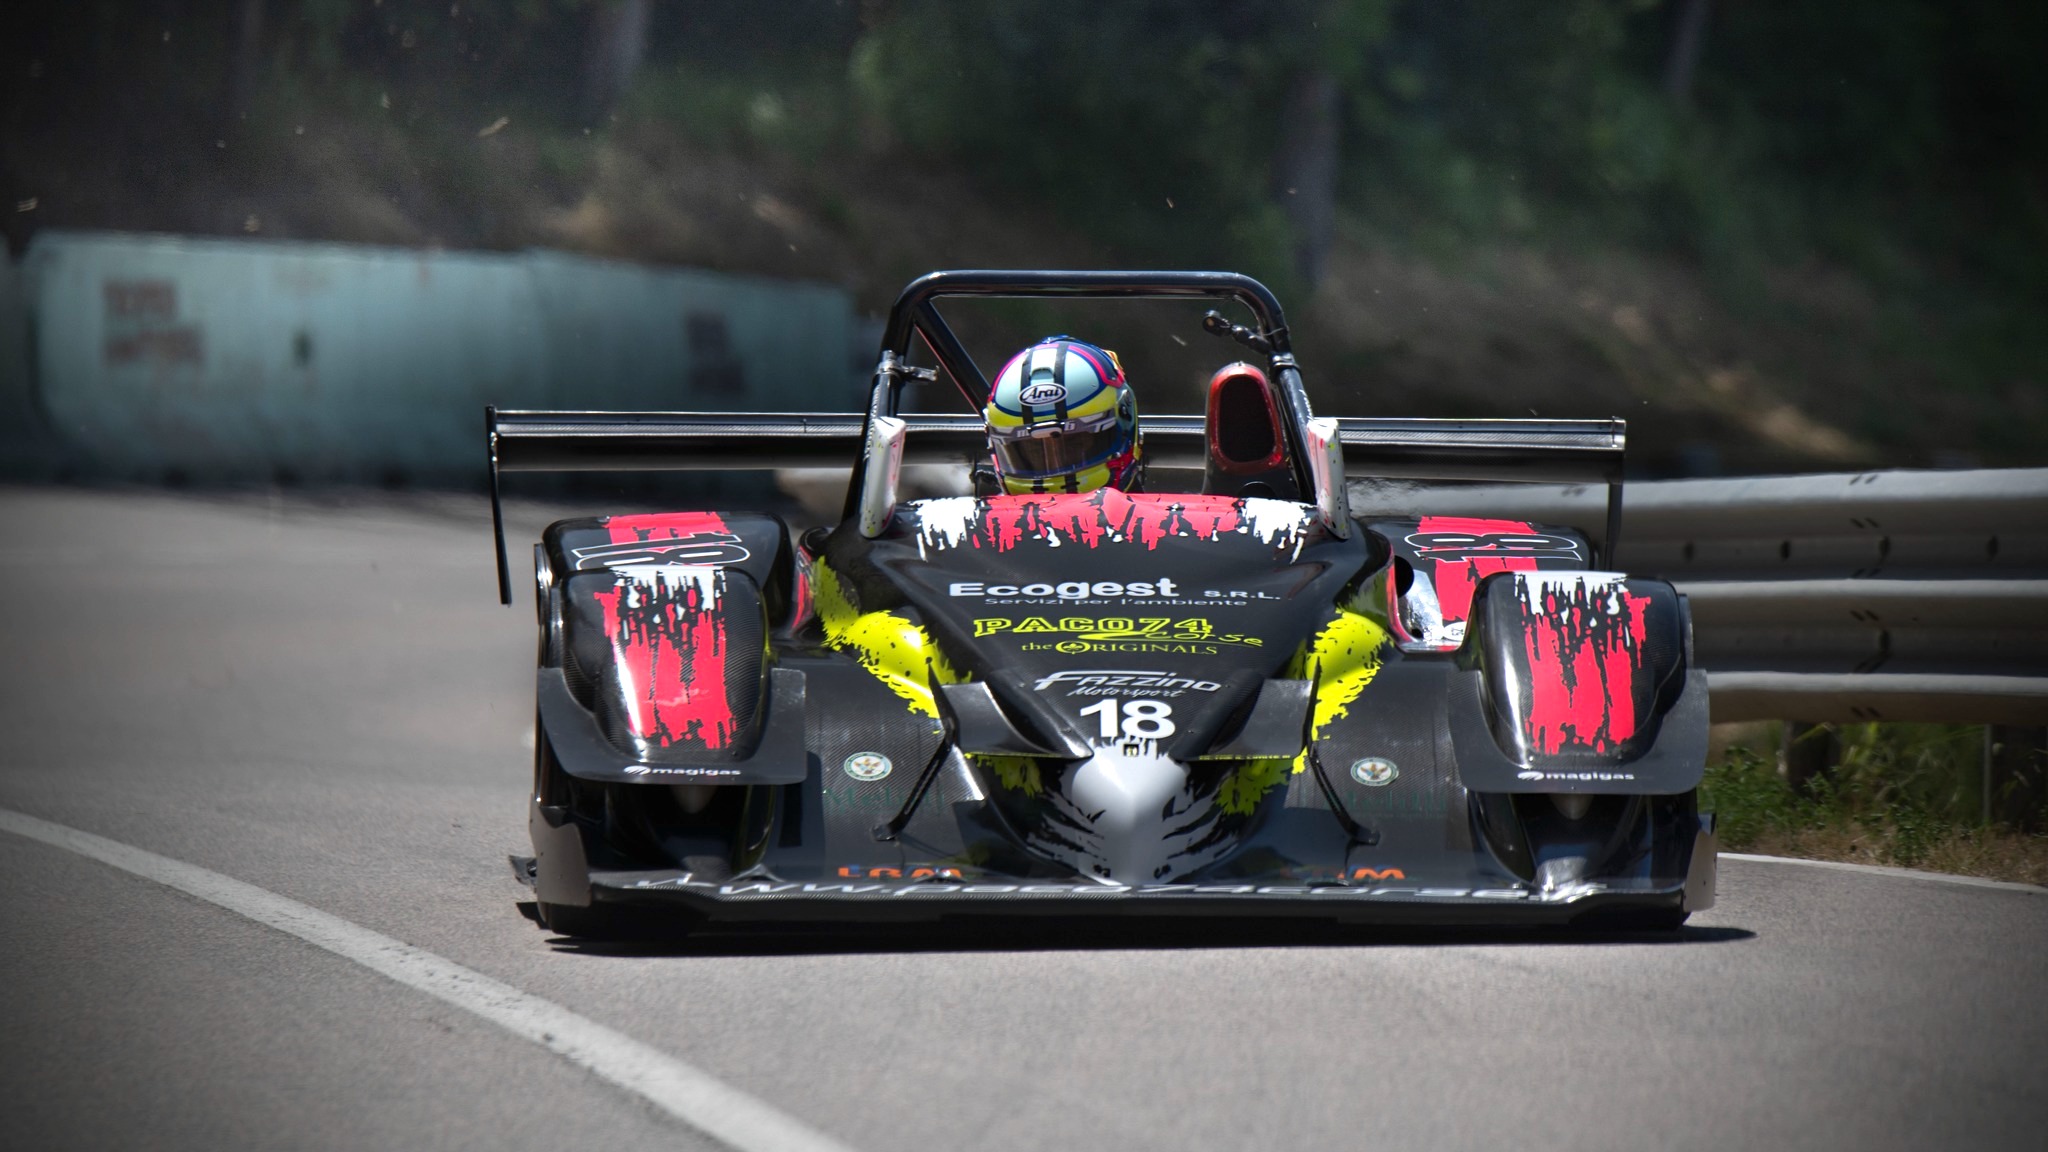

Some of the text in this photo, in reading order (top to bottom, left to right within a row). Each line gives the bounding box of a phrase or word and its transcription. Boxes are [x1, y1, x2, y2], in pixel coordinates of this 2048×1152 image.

[1027, 386, 1060, 400] Arai
[949, 577, 1281, 600] Ecogest S.R.L.
[1074, 598, 1112, 606] per
[1121, 598, 1247, 606] l'ambiente
[973, 617, 1213, 637] PACO74
[1021, 640, 1218, 655] the ORIGINALS
[1066, 686, 1187, 698] Motorsport
[1080, 698, 1176, 739] 18
[652, 767, 741, 776] magigas
[1545, 771, 1634, 781] magigas
